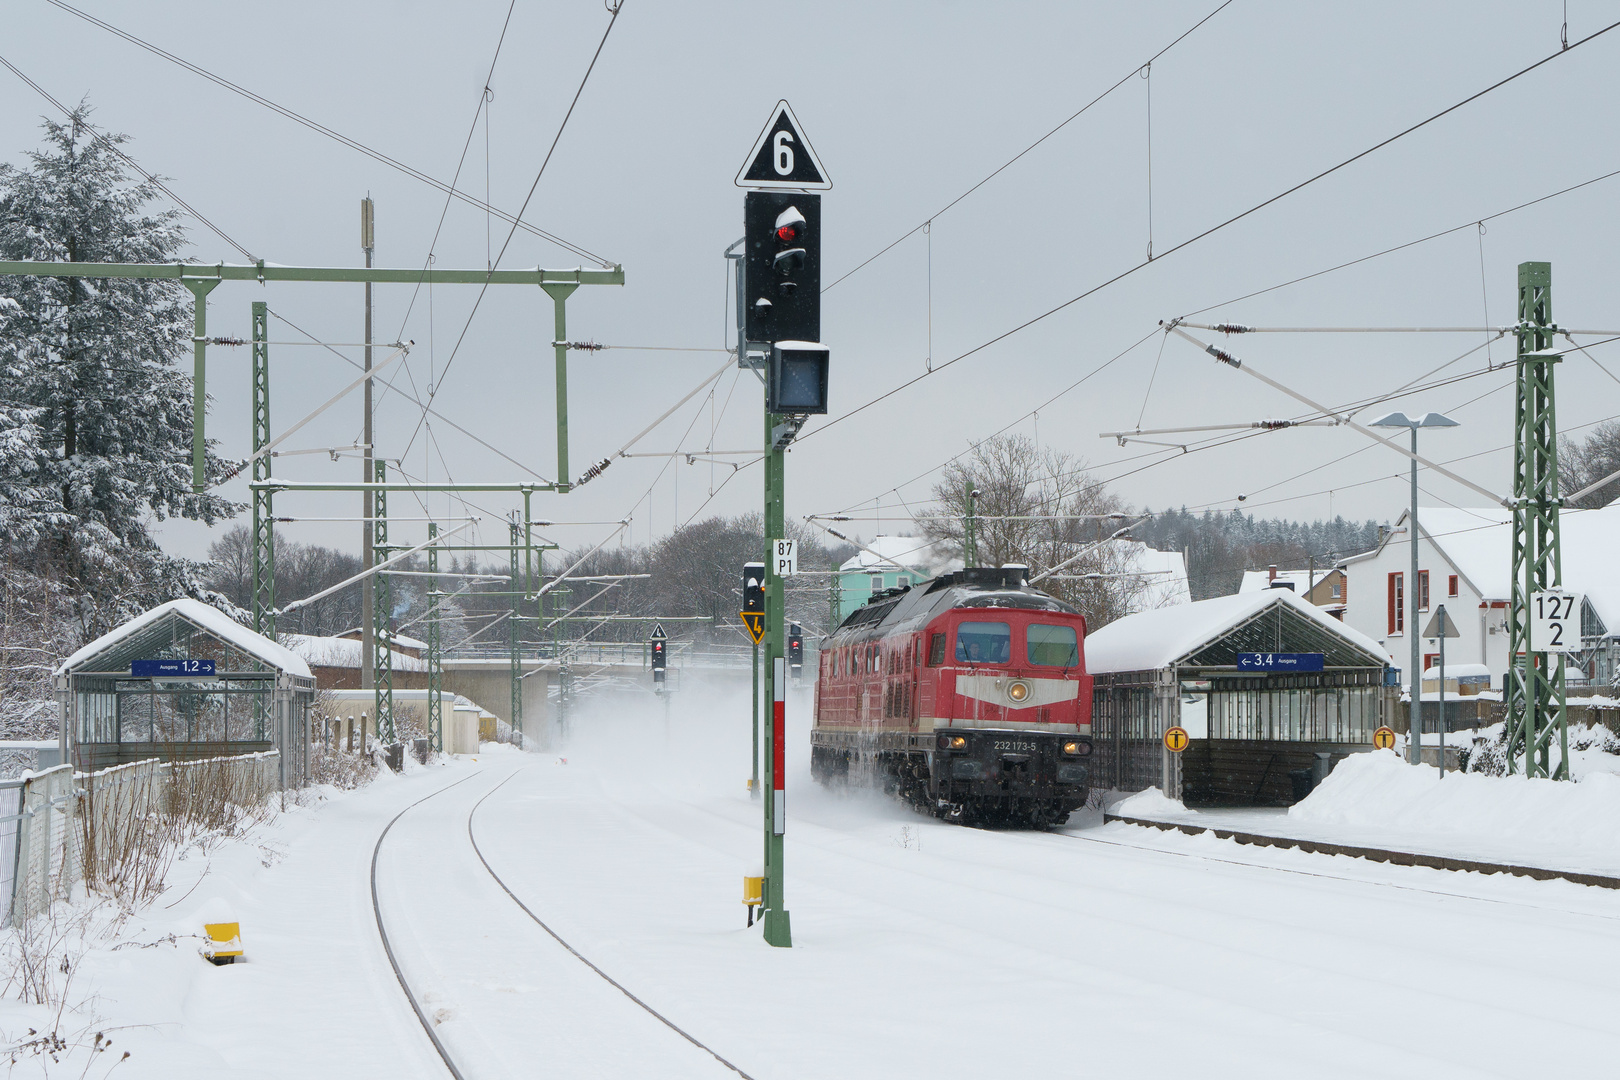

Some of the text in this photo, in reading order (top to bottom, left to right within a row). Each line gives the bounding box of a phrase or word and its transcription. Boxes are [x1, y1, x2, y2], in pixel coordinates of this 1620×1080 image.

[773, 130, 795, 176] 6
[778, 542, 792, 555] 87
[779, 559, 791, 572] P1
[1536, 596, 1575, 619] 127
[754, 616, 762, 633] 4
[656, 627, 661, 637] 4
[1549, 622, 1563, 646] 2
[182, 660, 199, 672] 1,2
[994, 741, 1036, 751] 232 173-5
